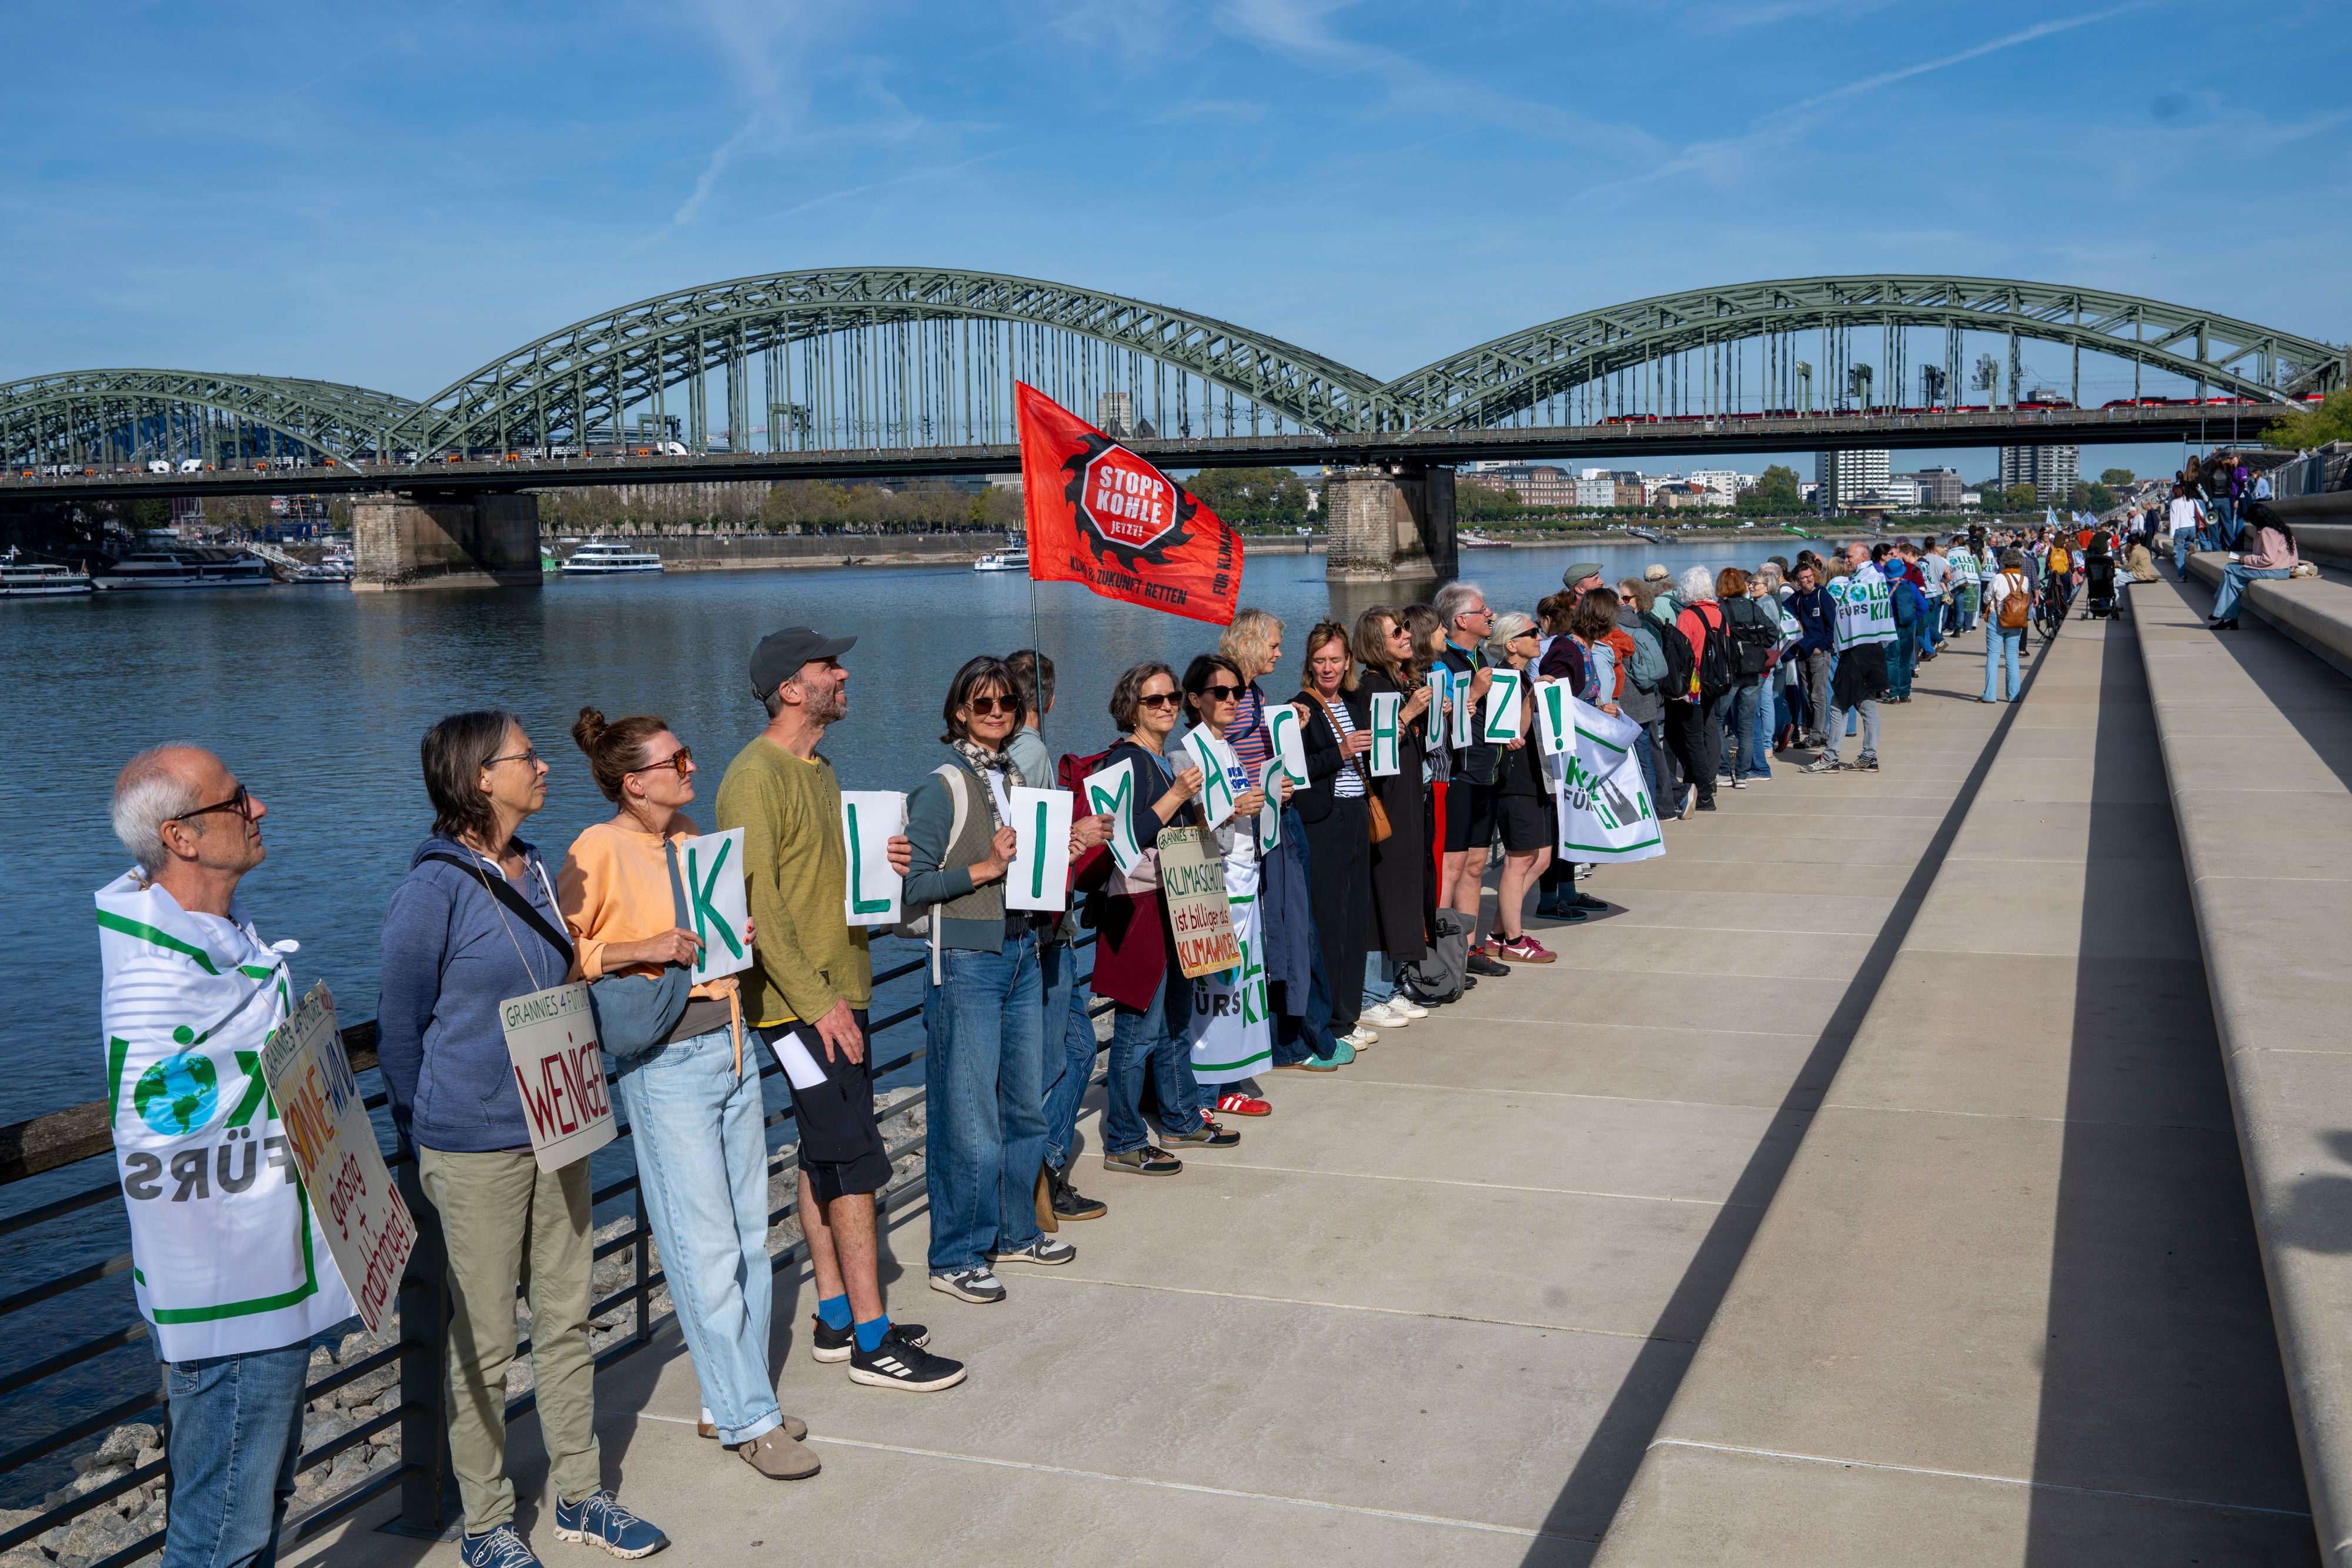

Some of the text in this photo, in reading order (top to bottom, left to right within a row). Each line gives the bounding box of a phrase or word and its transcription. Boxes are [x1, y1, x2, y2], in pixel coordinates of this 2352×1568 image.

[1096, 489, 1162, 524] KOHLE
[1100, 466, 1164, 500] STOPP
[1111, 520, 1144, 537] JETZT!
[1088, 567, 1094, 583] &
[1097, 569, 1142, 594] ZUKUNFT
[1145, 581, 1187, 606] RETTEN
[1212, 573, 1229, 596] FÜR
[1839, 604, 1868, 619] FÜRS
[1429, 674, 1445, 744] U
[1455, 677, 1469, 742] T
[1486, 674, 1518, 738] Z
[1374, 698, 1398, 771] H
[1192, 733, 1232, 821] A
[1091, 770, 1138, 869] M
[1263, 760, 1282, 850] S
[847, 803, 891, 914] L
[1032, 801, 1047, 899] I
[1158, 830, 1187, 850] GRANNIES
[1190, 828, 1194, 840] 4
[1195, 829, 1210, 841] FUTURE
[1164, 862, 1227, 897] KLIMASCHUTZ
[688, 838, 743, 973] K
[1174, 902, 1228, 932] ist billiger als
[1177, 933, 1239, 969] KLIMAWANDEL
[506, 995, 558, 1027] GRANNIES
[560, 993, 567, 1012] 4
[1192, 986, 1241, 1017] ÜRS
[265, 1024, 295, 1090] GRANNIES
[298, 997, 322, 1040] FUTURE
[320, 989, 334, 1012] KÖLN
[330, 1151, 366, 1242] günstig
